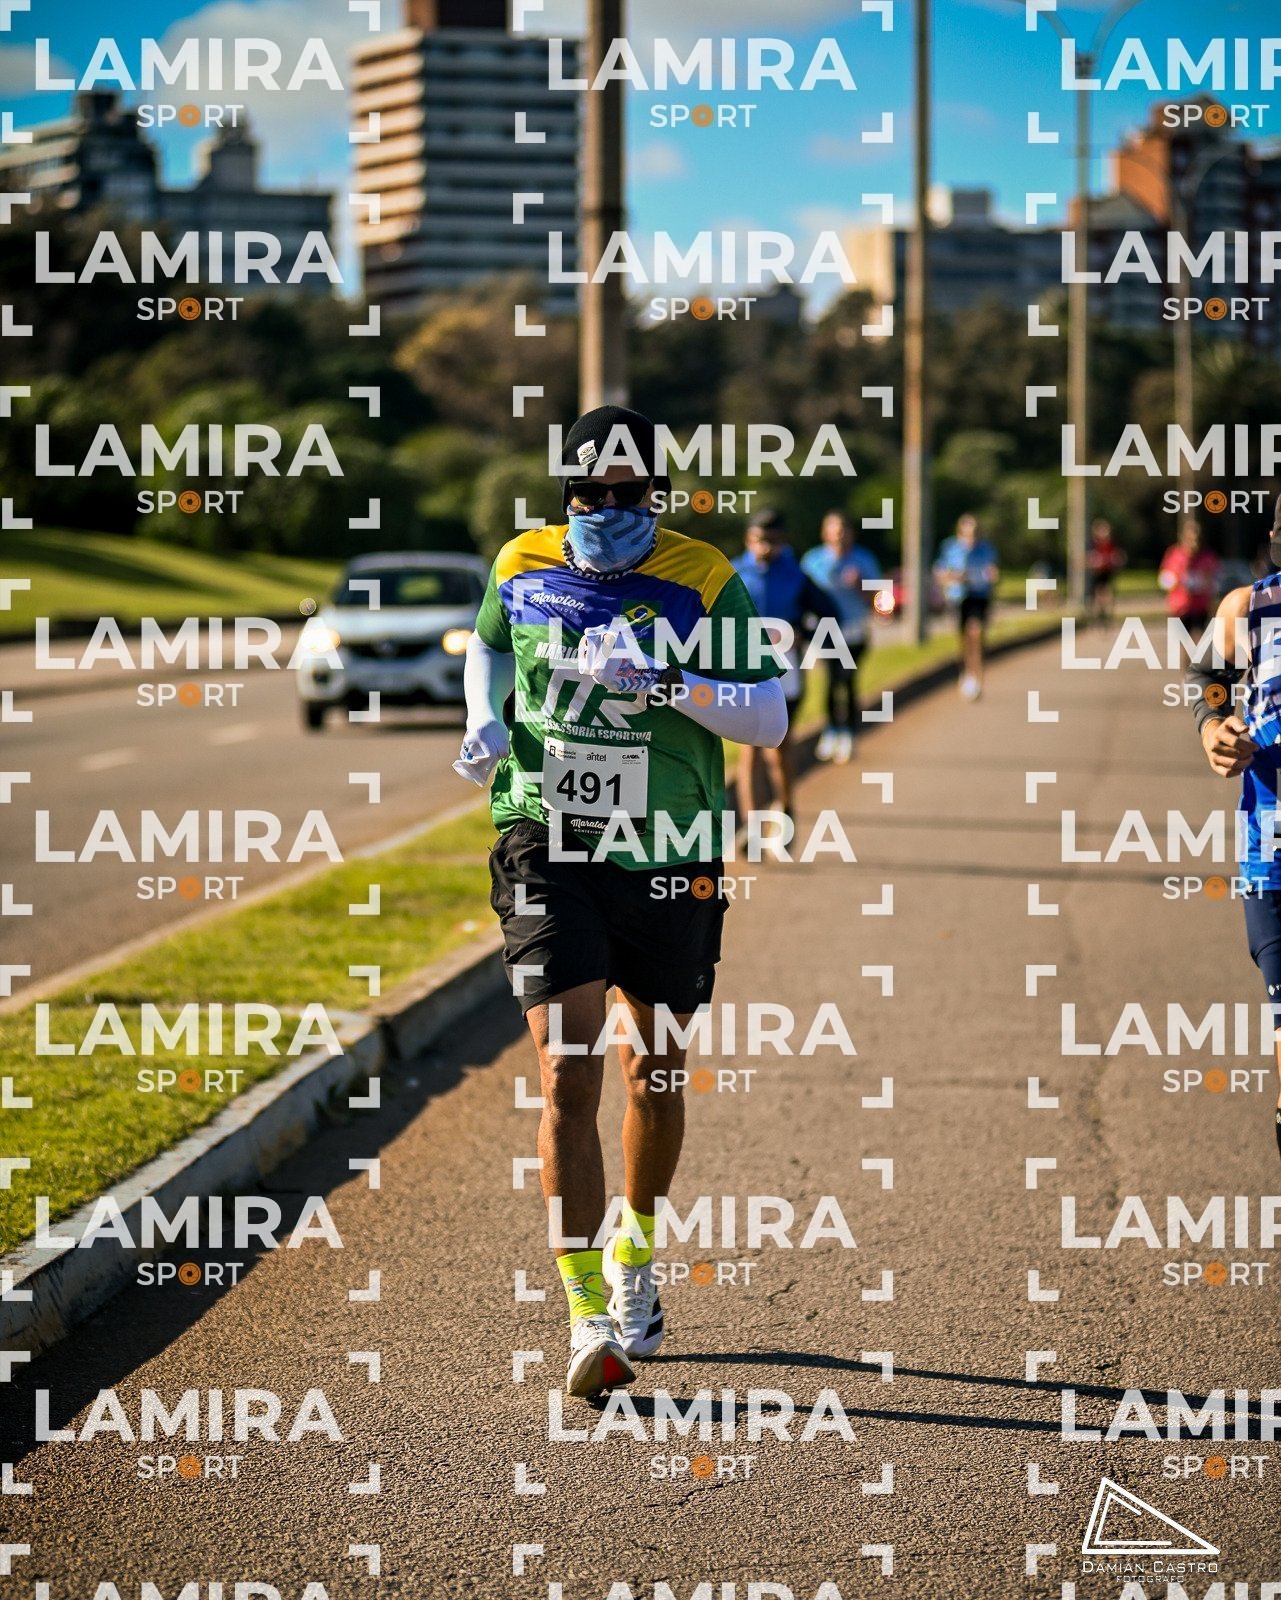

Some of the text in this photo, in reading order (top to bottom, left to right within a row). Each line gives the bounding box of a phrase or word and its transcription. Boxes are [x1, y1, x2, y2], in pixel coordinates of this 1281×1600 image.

[544, 718, 652, 742] ASSESSORIA ESPORTIVA
[586, 752, 607, 762] antel
[556, 769, 621, 806] 491
